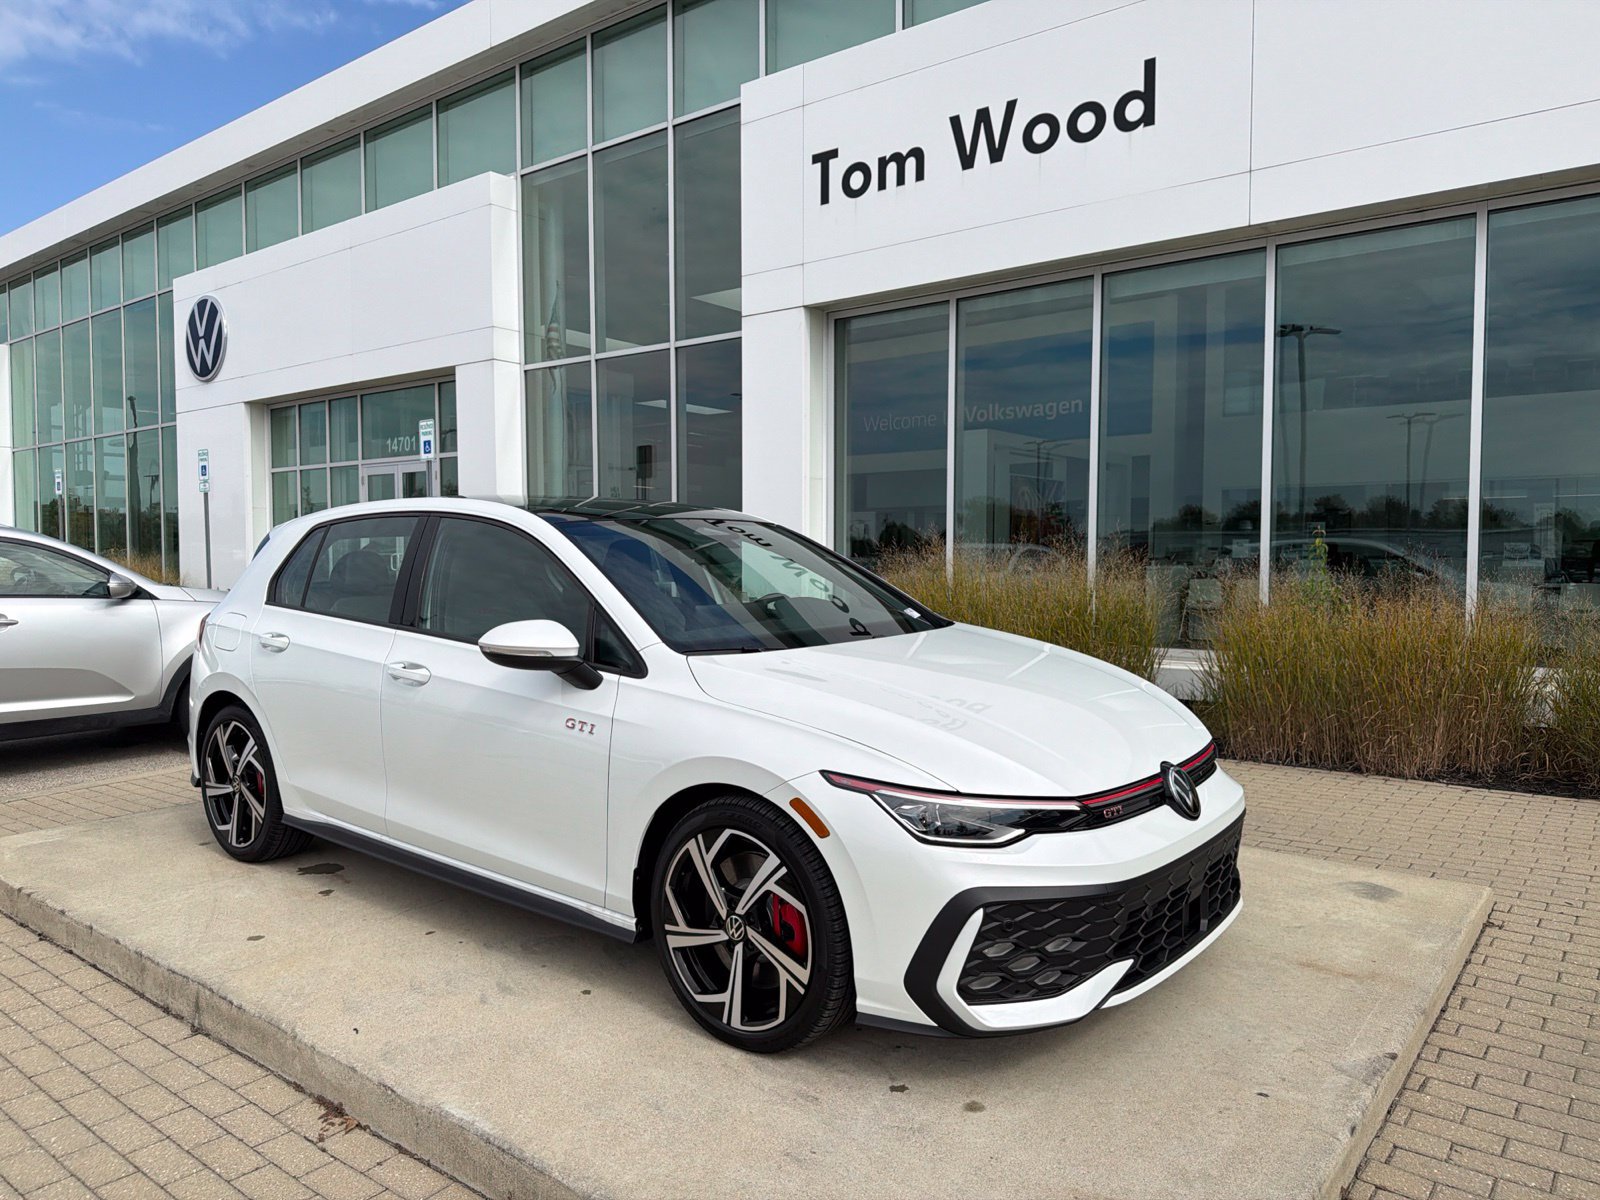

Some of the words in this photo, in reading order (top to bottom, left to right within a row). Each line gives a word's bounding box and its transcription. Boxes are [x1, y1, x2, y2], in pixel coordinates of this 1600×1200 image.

[811, 147, 926, 205] Tom
[948, 56, 1157, 171] Wood
[863, 413, 937, 432] Welcome
[964, 399, 1083, 423] Volkswagen
[386, 435, 416, 453] 14701
[565, 717, 596, 735] GTI
[1103, 805, 1123, 819] GTI
